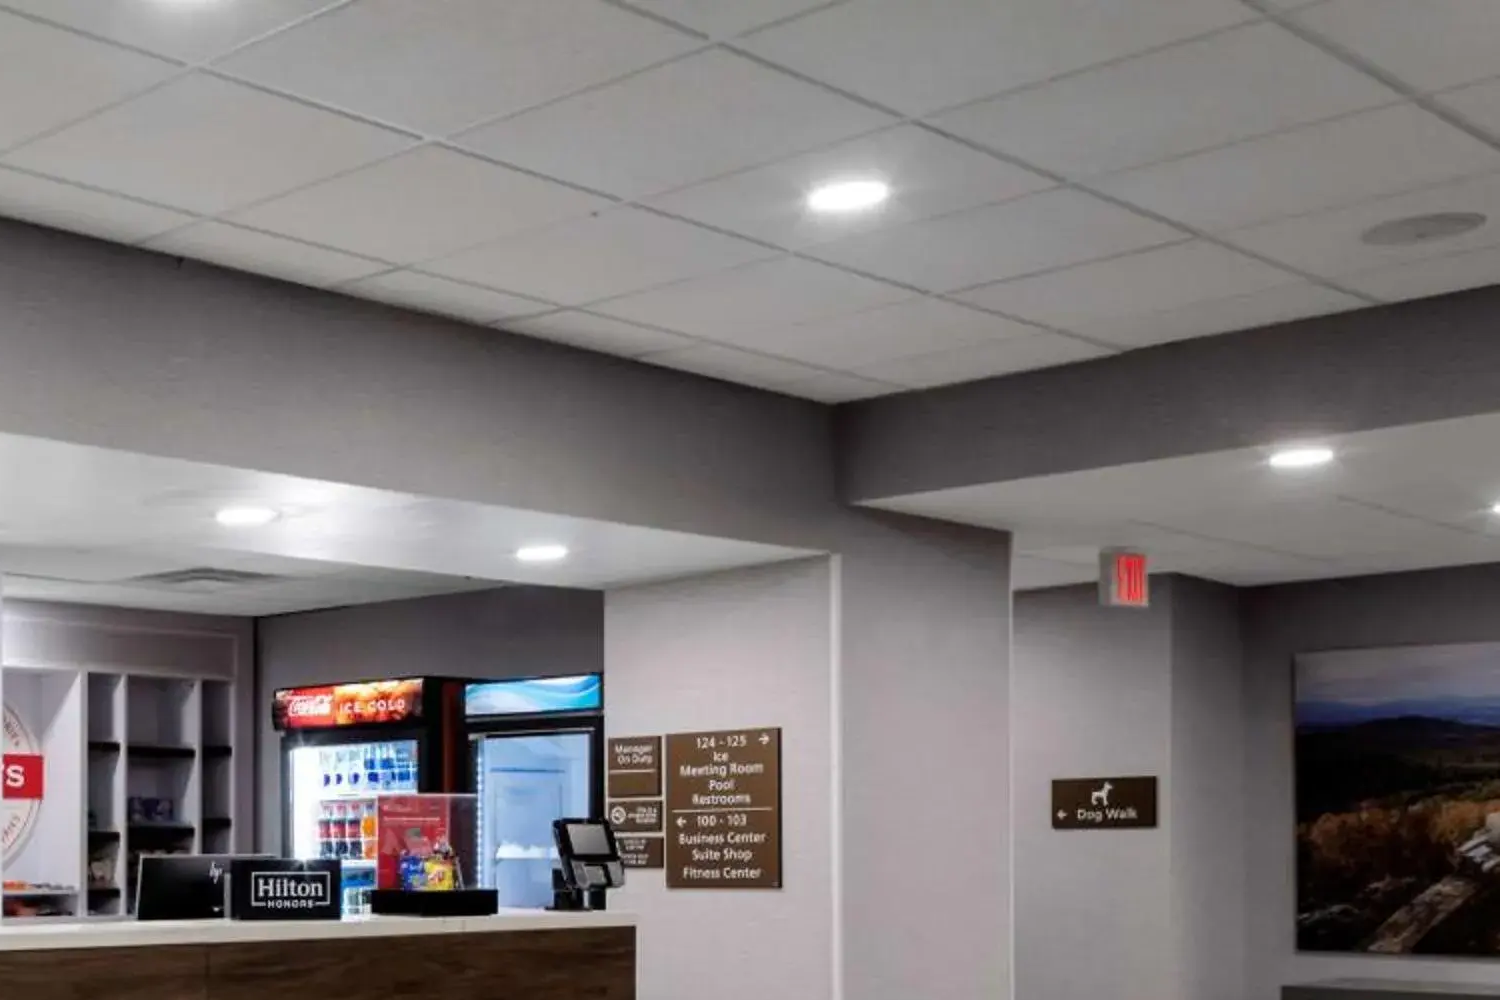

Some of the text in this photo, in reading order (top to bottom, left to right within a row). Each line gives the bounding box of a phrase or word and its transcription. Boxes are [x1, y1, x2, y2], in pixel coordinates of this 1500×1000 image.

[339, 699, 405, 714] ICE COLD
[696, 736, 715, 749] 124
[727, 735, 747, 748] 125
[713, 751, 729, 762] Ice
[1, 763, 25, 788] S
[680, 763, 764, 778] Meeting Room
[709, 779, 735, 791] Pool
[692, 794, 751, 805] Restrooms
[697, 815, 717, 827] 100
[727, 813, 747, 826] 103
[1077, 807, 1138, 823] Dog Walk
[678, 832, 766, 845] Business Center
[692, 848, 753, 862] Suite Shop
[683, 867, 762, 879] Fitness Center
[258, 878, 324, 897] Hilton
[267, 900, 314, 909] HONORS
